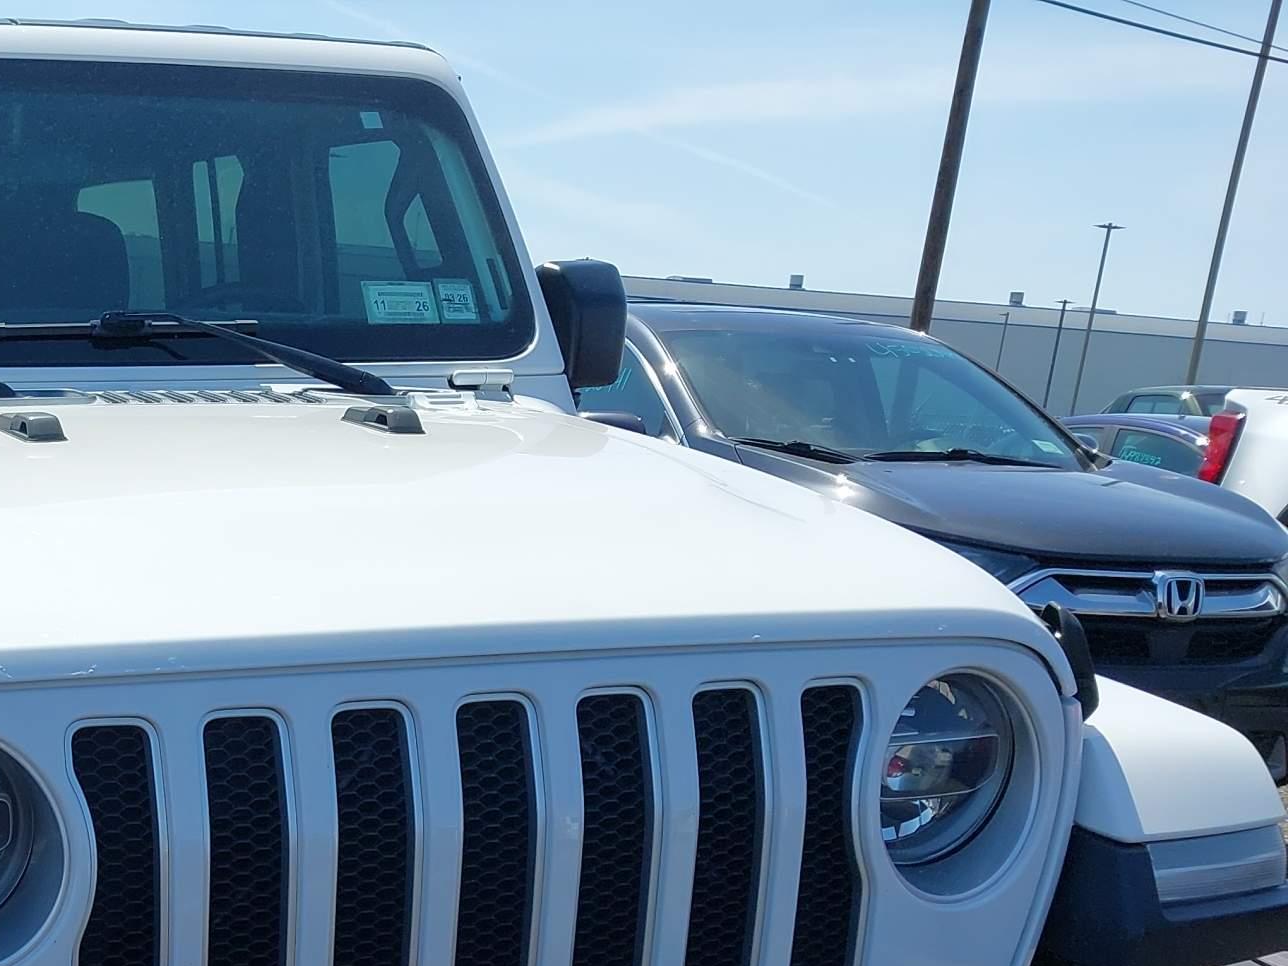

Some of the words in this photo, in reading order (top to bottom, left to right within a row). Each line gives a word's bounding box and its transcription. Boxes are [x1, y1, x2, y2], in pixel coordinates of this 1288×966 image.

[456, 293, 469, 303] 26
[373, 299, 387, 312] 11
[415, 300, 430, 312] 26
